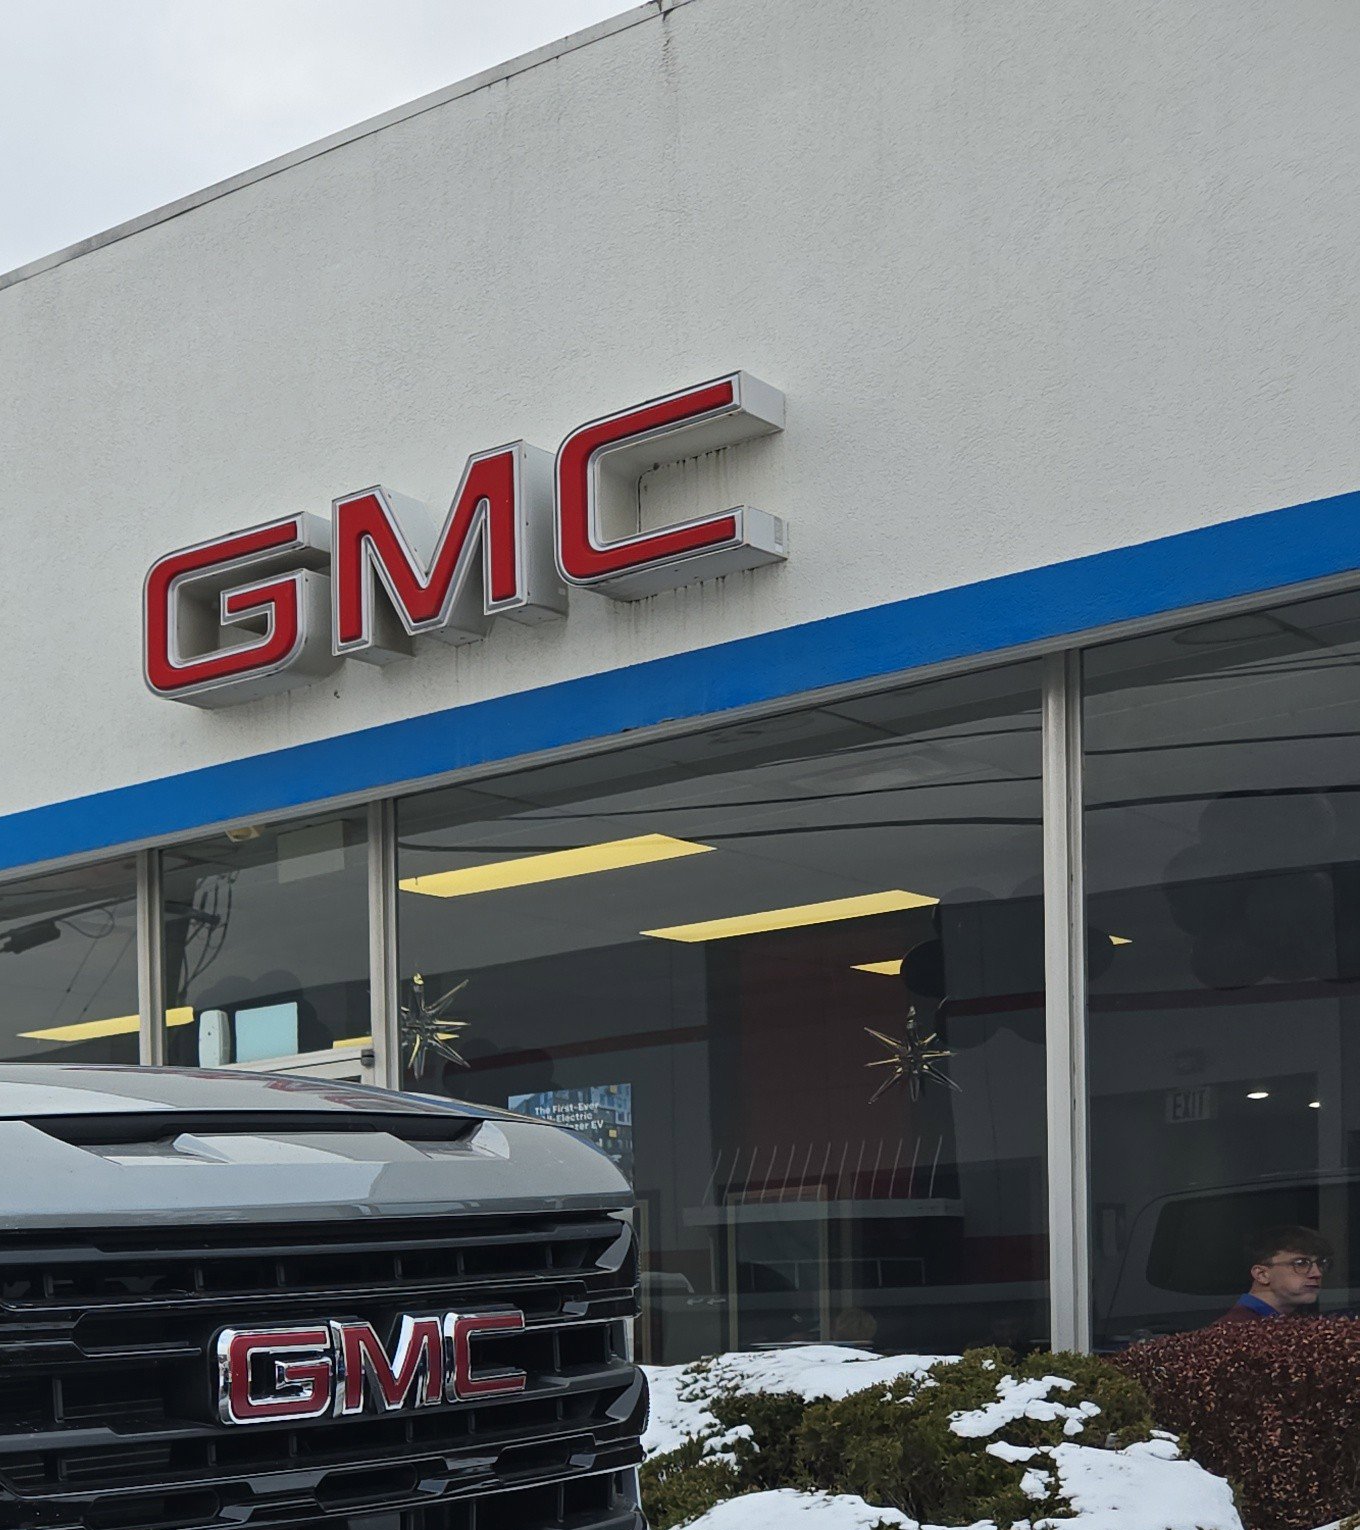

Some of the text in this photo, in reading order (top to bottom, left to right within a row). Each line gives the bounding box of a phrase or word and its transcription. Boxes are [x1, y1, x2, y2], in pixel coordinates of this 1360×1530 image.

[143, 370, 784, 704] GMC
[535, 1102, 599, 1115] The First-Ever
[1172, 1090, 1206, 1120] EXIT
[590, 1119, 604, 1129] EV
[216, 1310, 527, 1425] GMC
